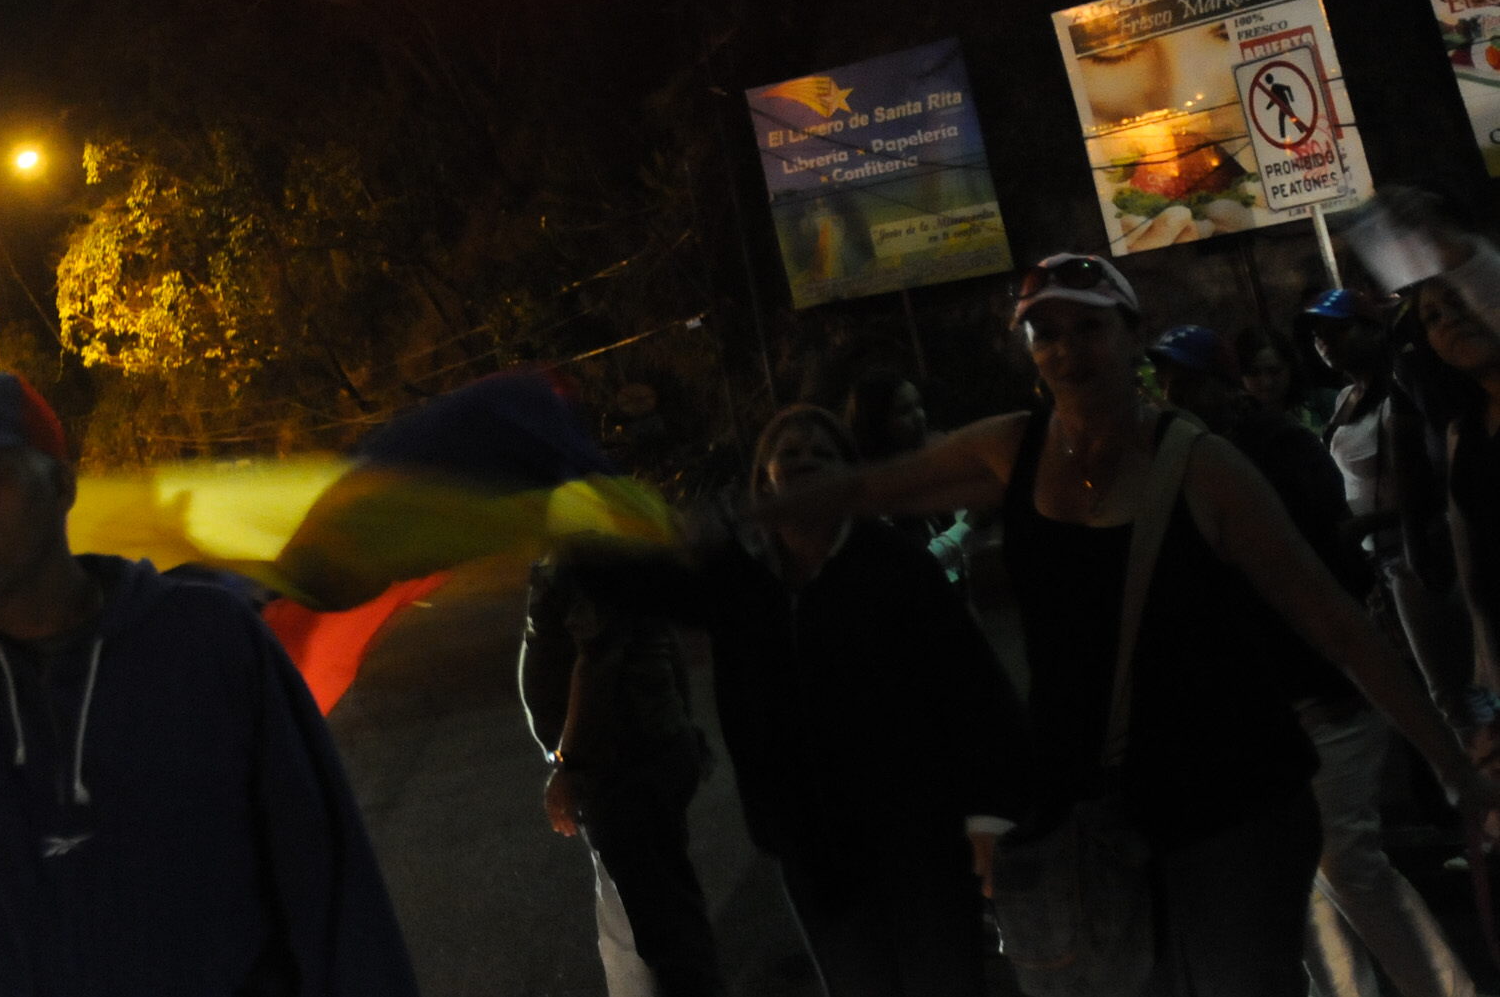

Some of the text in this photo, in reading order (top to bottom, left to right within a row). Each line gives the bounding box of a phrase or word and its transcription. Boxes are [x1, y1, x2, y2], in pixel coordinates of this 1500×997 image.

[1114, 9, 1173, 38] Fresco
[1234, 14, 1265, 29] 100%
[1237, 20, 1288, 41] FRESCO
[767, 131, 783, 148] El
[849, 112, 870, 130] de
[874, 99, 922, 124] Santa
[927, 90, 963, 111] Rita
[781, 124, 959, 175] Librería Papelería
[832, 155, 919, 183] Confitería
[1265, 149, 1336, 179] PROHIBIDO
[1271, 172, 1340, 200] PEATONES
